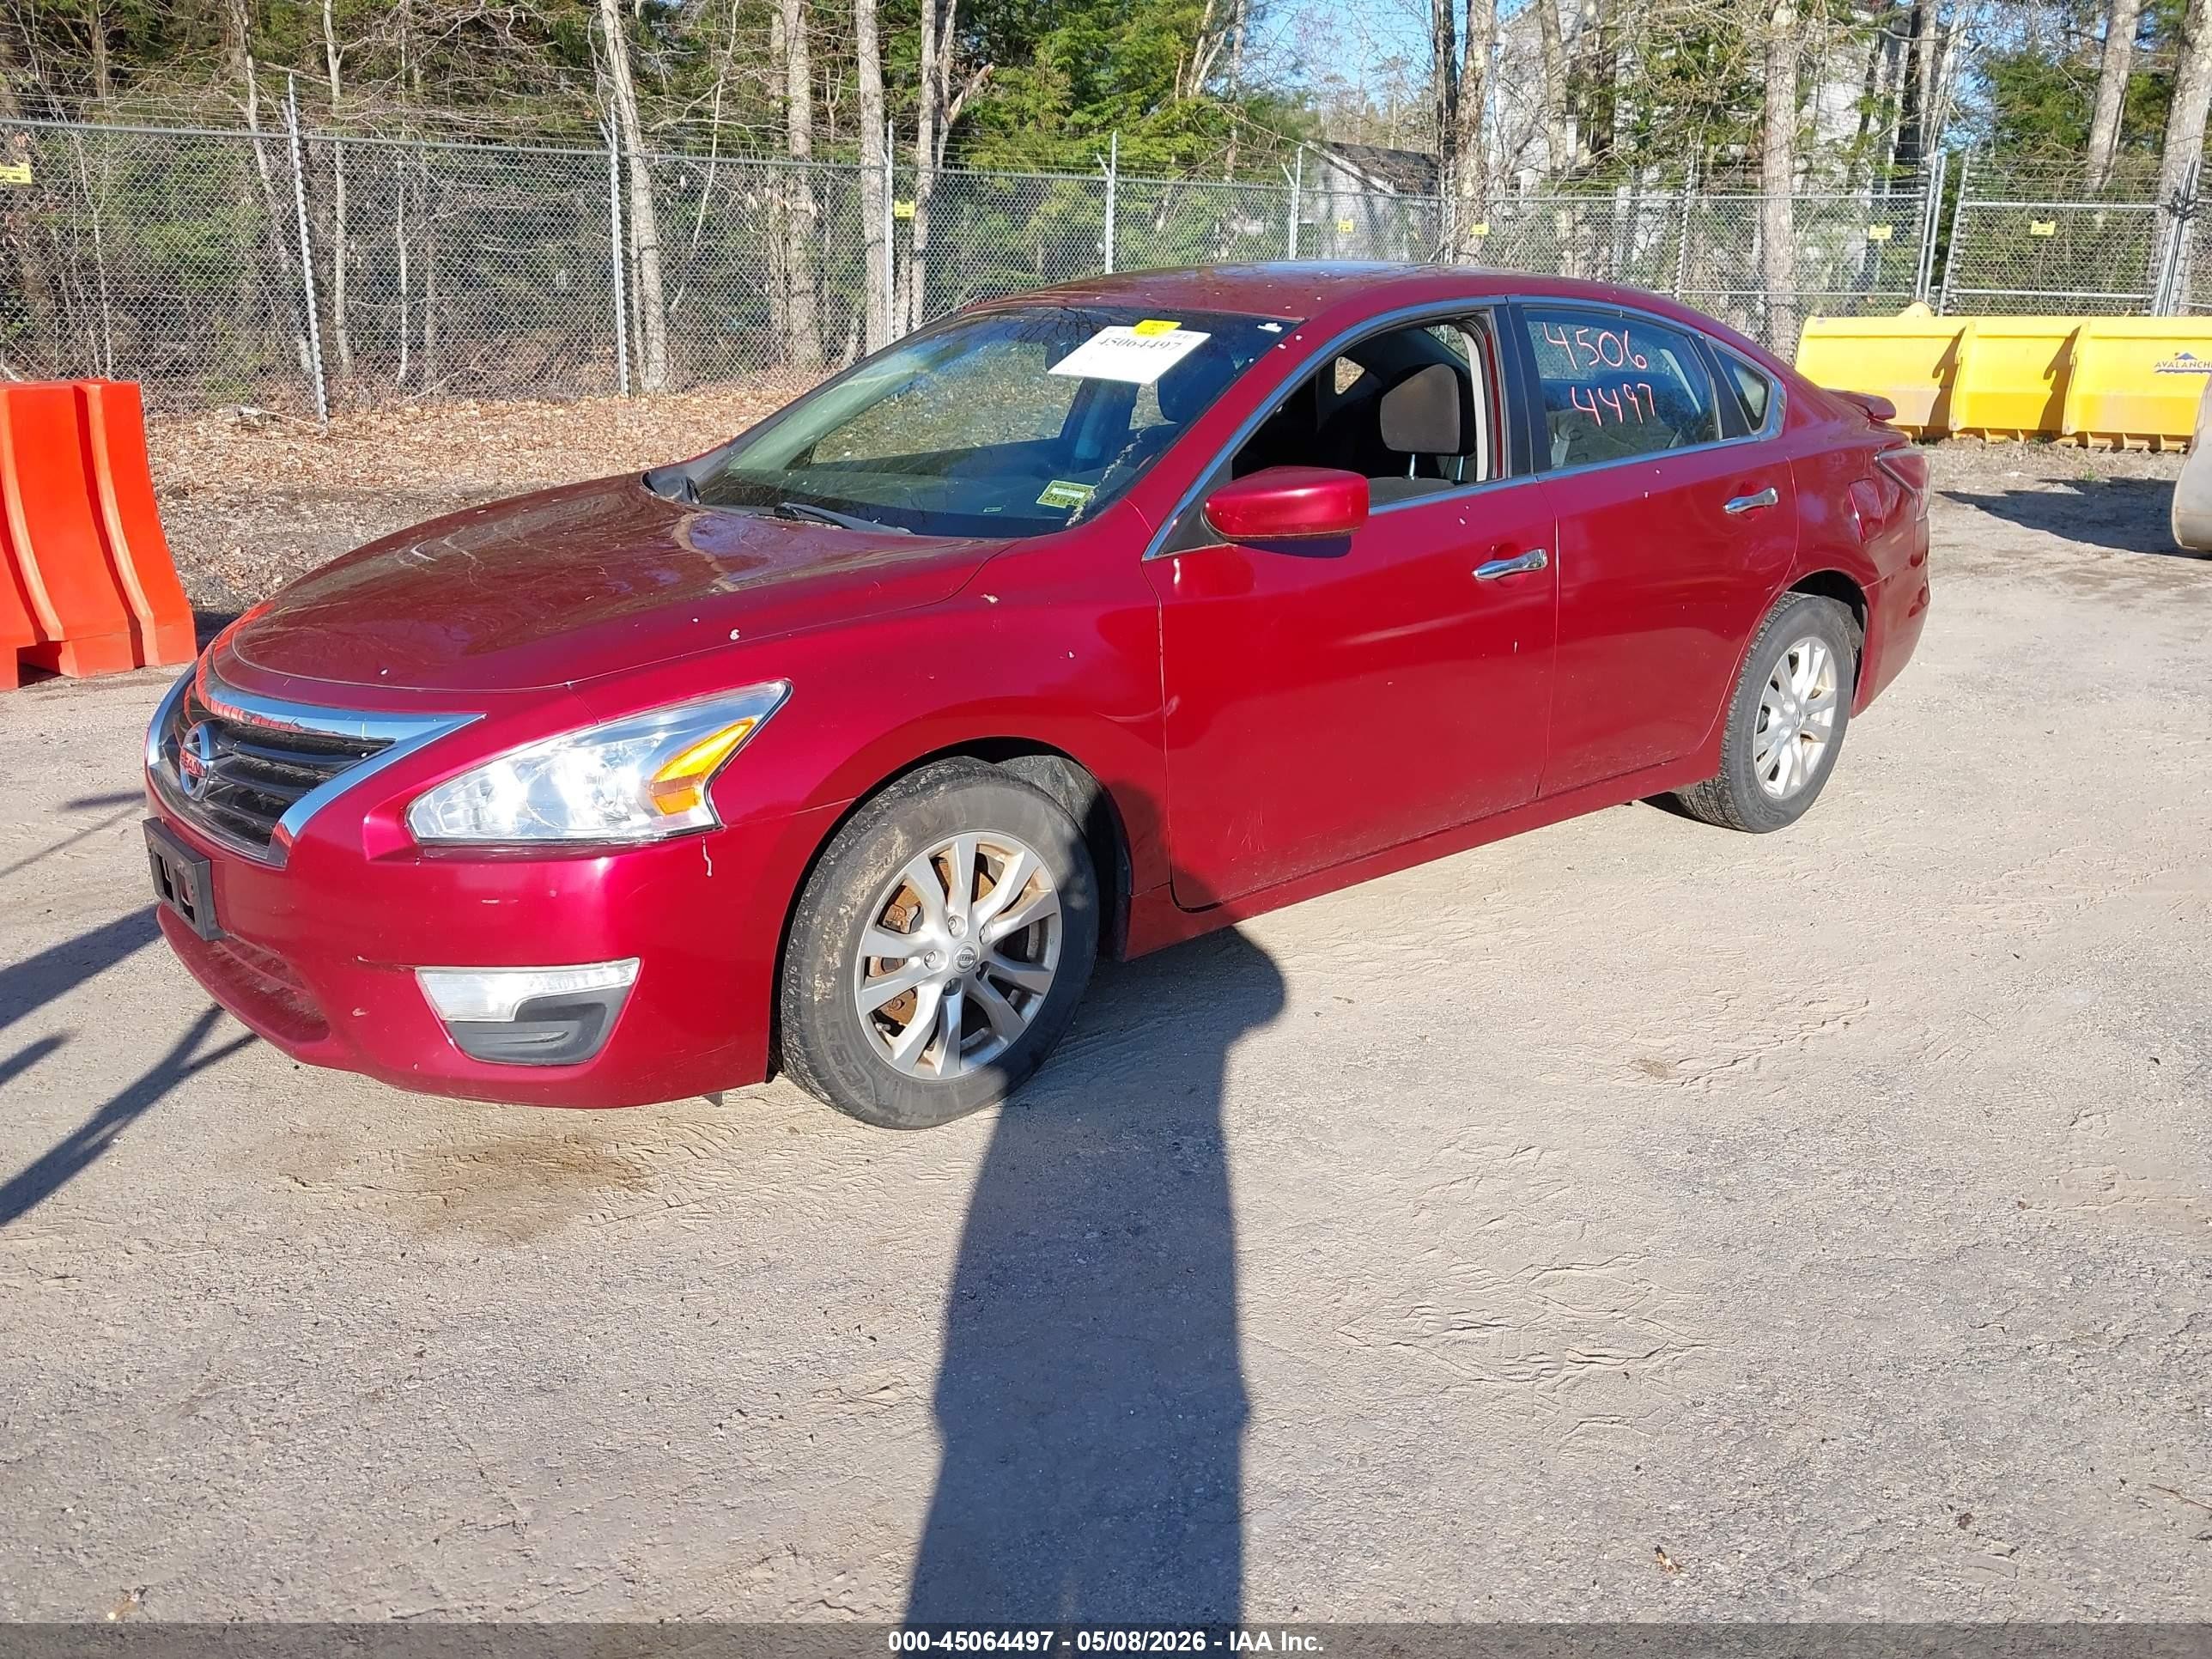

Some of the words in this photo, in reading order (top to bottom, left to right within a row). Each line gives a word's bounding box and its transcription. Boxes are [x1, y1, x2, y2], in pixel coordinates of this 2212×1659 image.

[1542, 321, 1649, 371] 4506
[2154, 361, 2212, 369] AVALANCH
[1571, 382, 1656, 427] 4497
[1044, 492, 1058, 501] 25
[1067, 496, 1080, 505] 26
